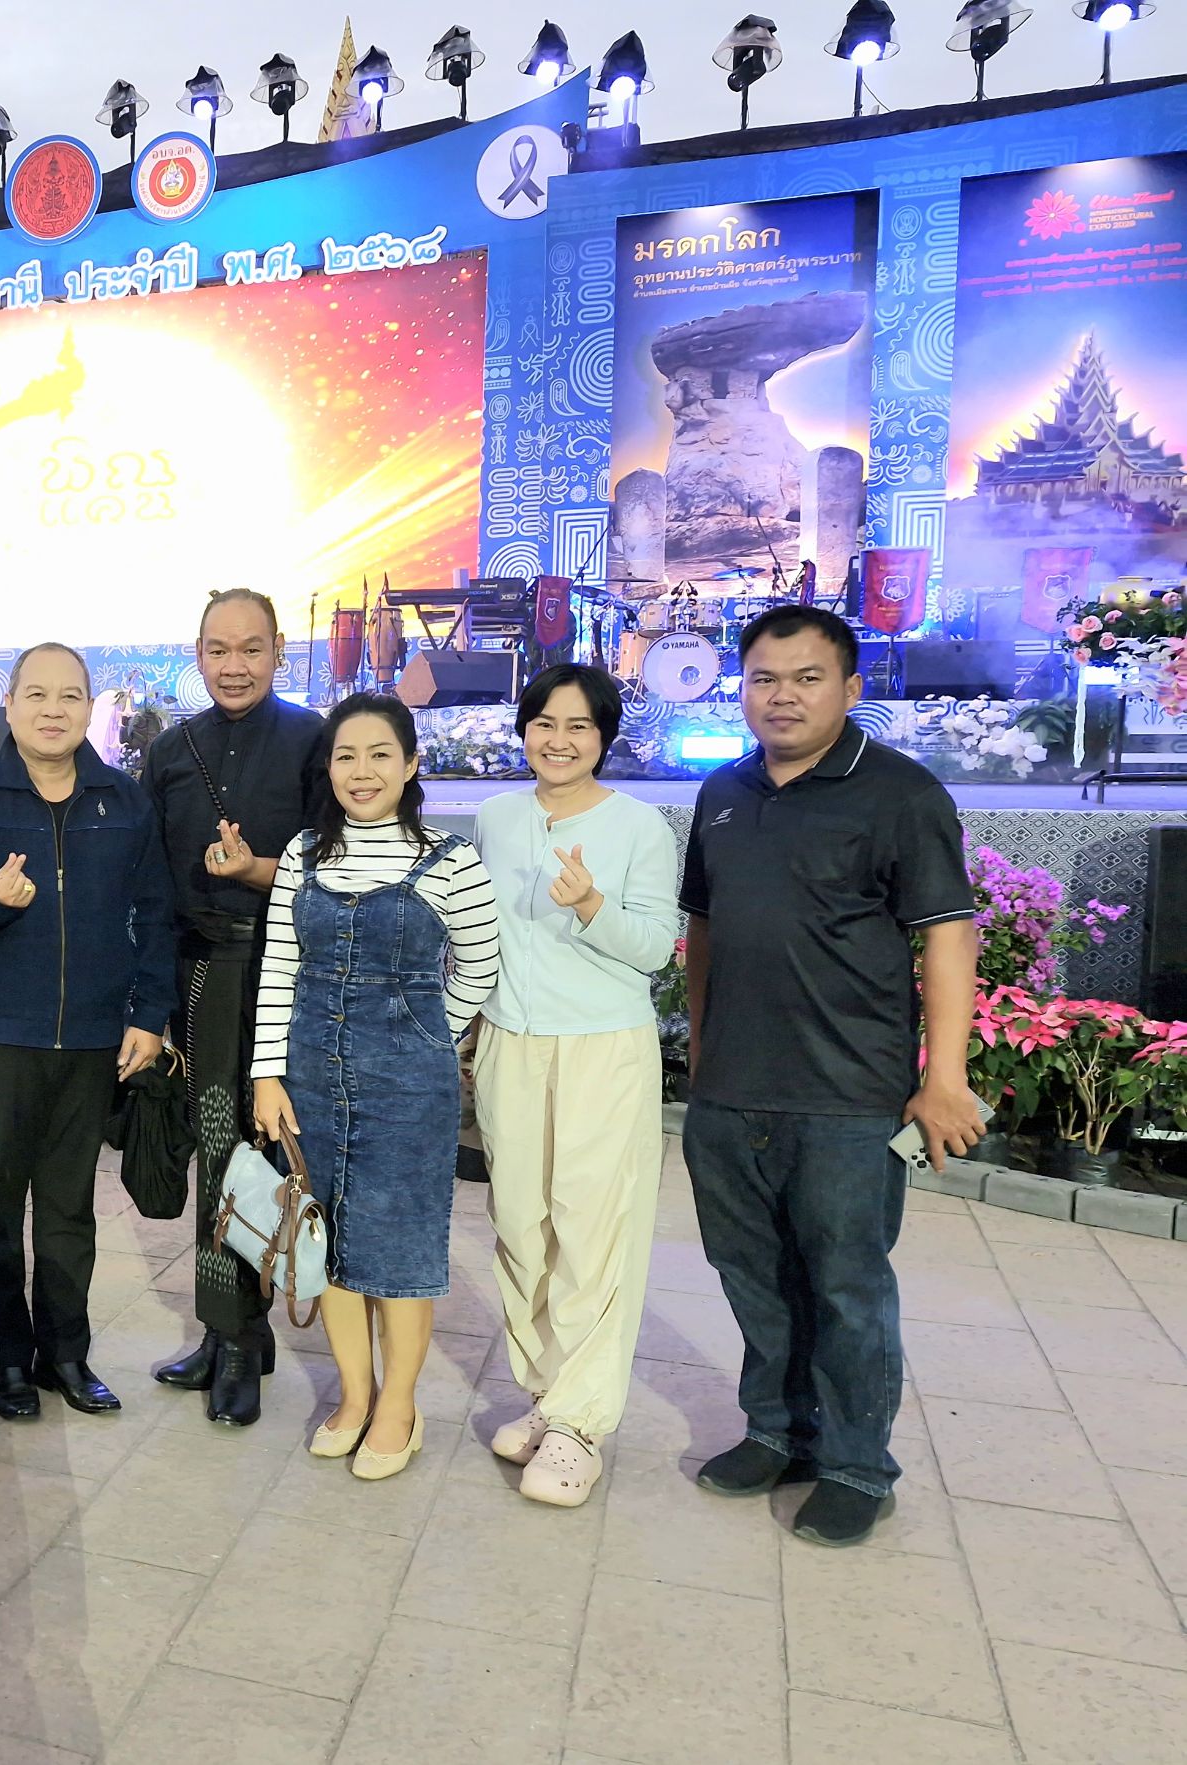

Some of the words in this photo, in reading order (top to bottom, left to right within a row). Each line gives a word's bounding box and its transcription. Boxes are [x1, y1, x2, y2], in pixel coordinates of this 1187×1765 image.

[634, 216, 782, 262] มรดกโลก
[64, 241, 199, 303] ประจำปี
[223, 242, 303, 285] พ.ศ.
[321, 226, 447, 275] ๒๕๖๘
[633, 250, 862, 289] อุทยานประวัติศาสตร์ภูพระบาท
[670, 641, 700, 649] YAMAHA
